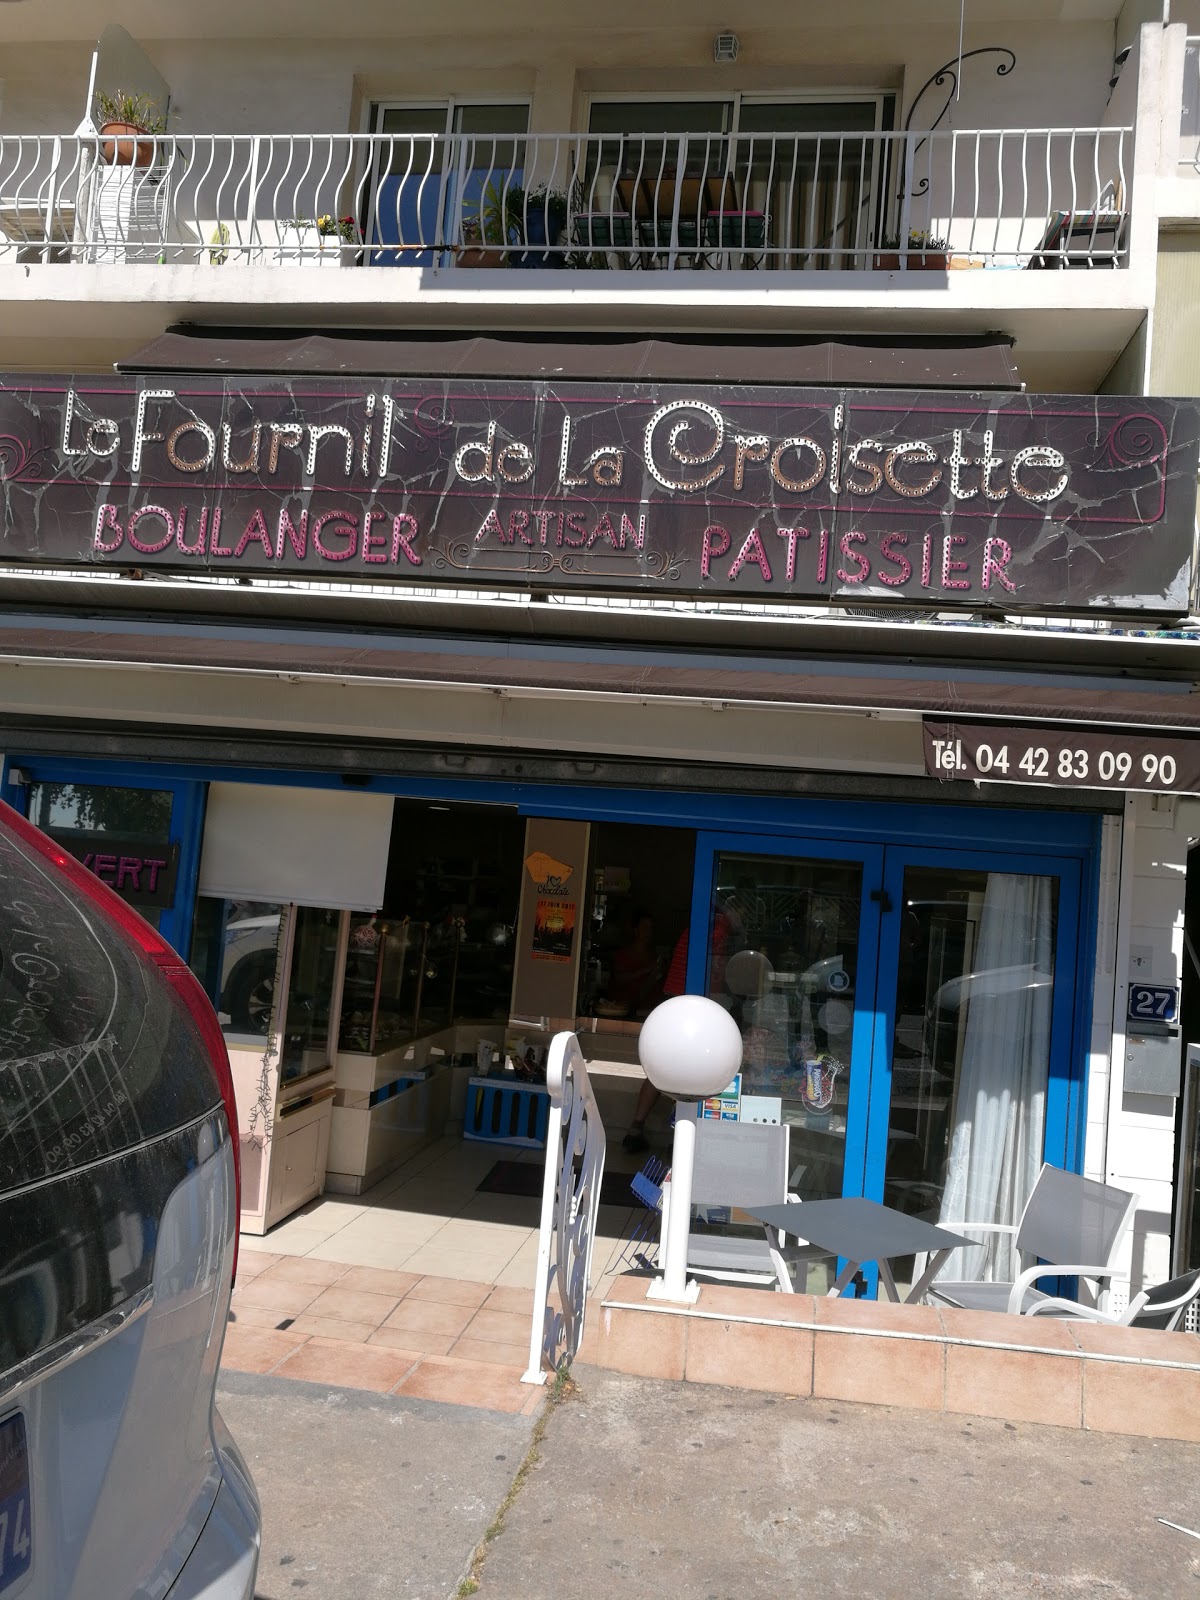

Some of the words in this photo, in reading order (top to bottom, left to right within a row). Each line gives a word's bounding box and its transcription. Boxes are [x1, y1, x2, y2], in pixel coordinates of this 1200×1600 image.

[63, 388, 121, 456] Le
[131, 388, 394, 478] Fournil
[455, 420, 535, 483] de
[559, 415, 624, 486] La
[645, 400, 1069, 502] Croisette
[94, 504, 423, 566] BOULANGER
[474, 509, 645, 549] ARTISAN
[701, 525, 1017, 594] PATISSIER
[932, 740, 967, 770] Tél.
[976, 744, 1010, 774] 04
[1018, 747, 1049, 777] 42
[1057, 748, 1089, 779] 83
[1098, 751, 1132, 781] 09
[1141, 755, 1177, 785] 90
[1136, 991, 1171, 1015] 27
